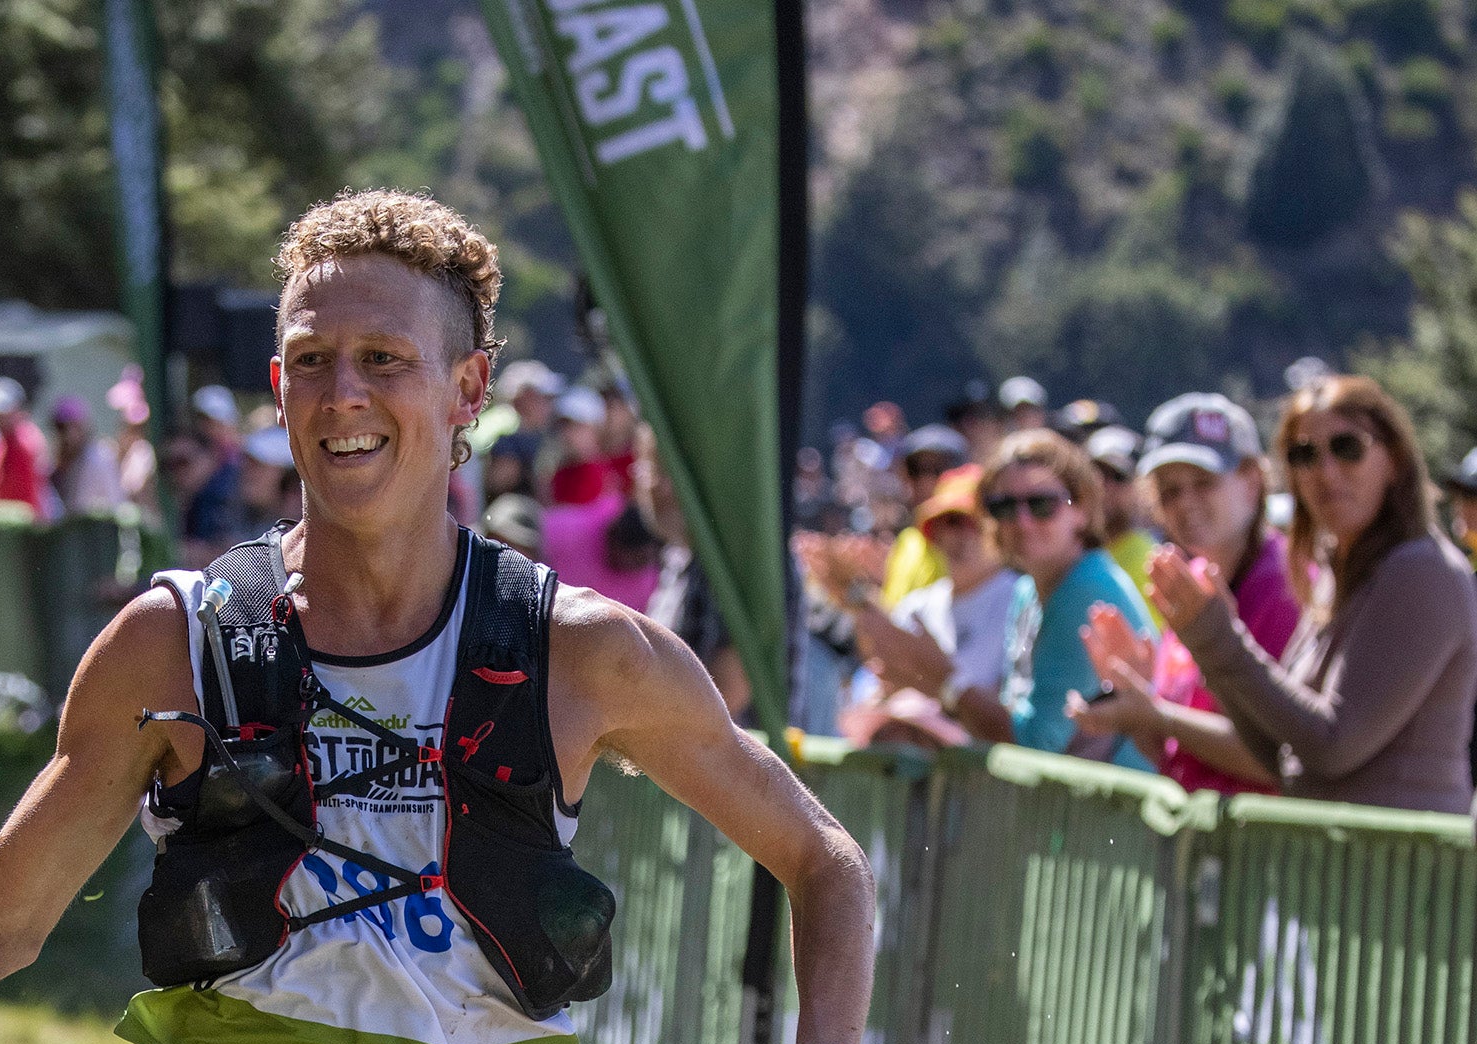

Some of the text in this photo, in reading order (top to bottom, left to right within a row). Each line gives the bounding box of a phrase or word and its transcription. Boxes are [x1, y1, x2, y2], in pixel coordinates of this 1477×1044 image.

[547, 0, 708, 165] AST
[303, 731, 343, 783] ST
[376, 736, 444, 789] COA
[316, 798, 435, 814] ULTI-SPRT CHAMPIONSHIPS
